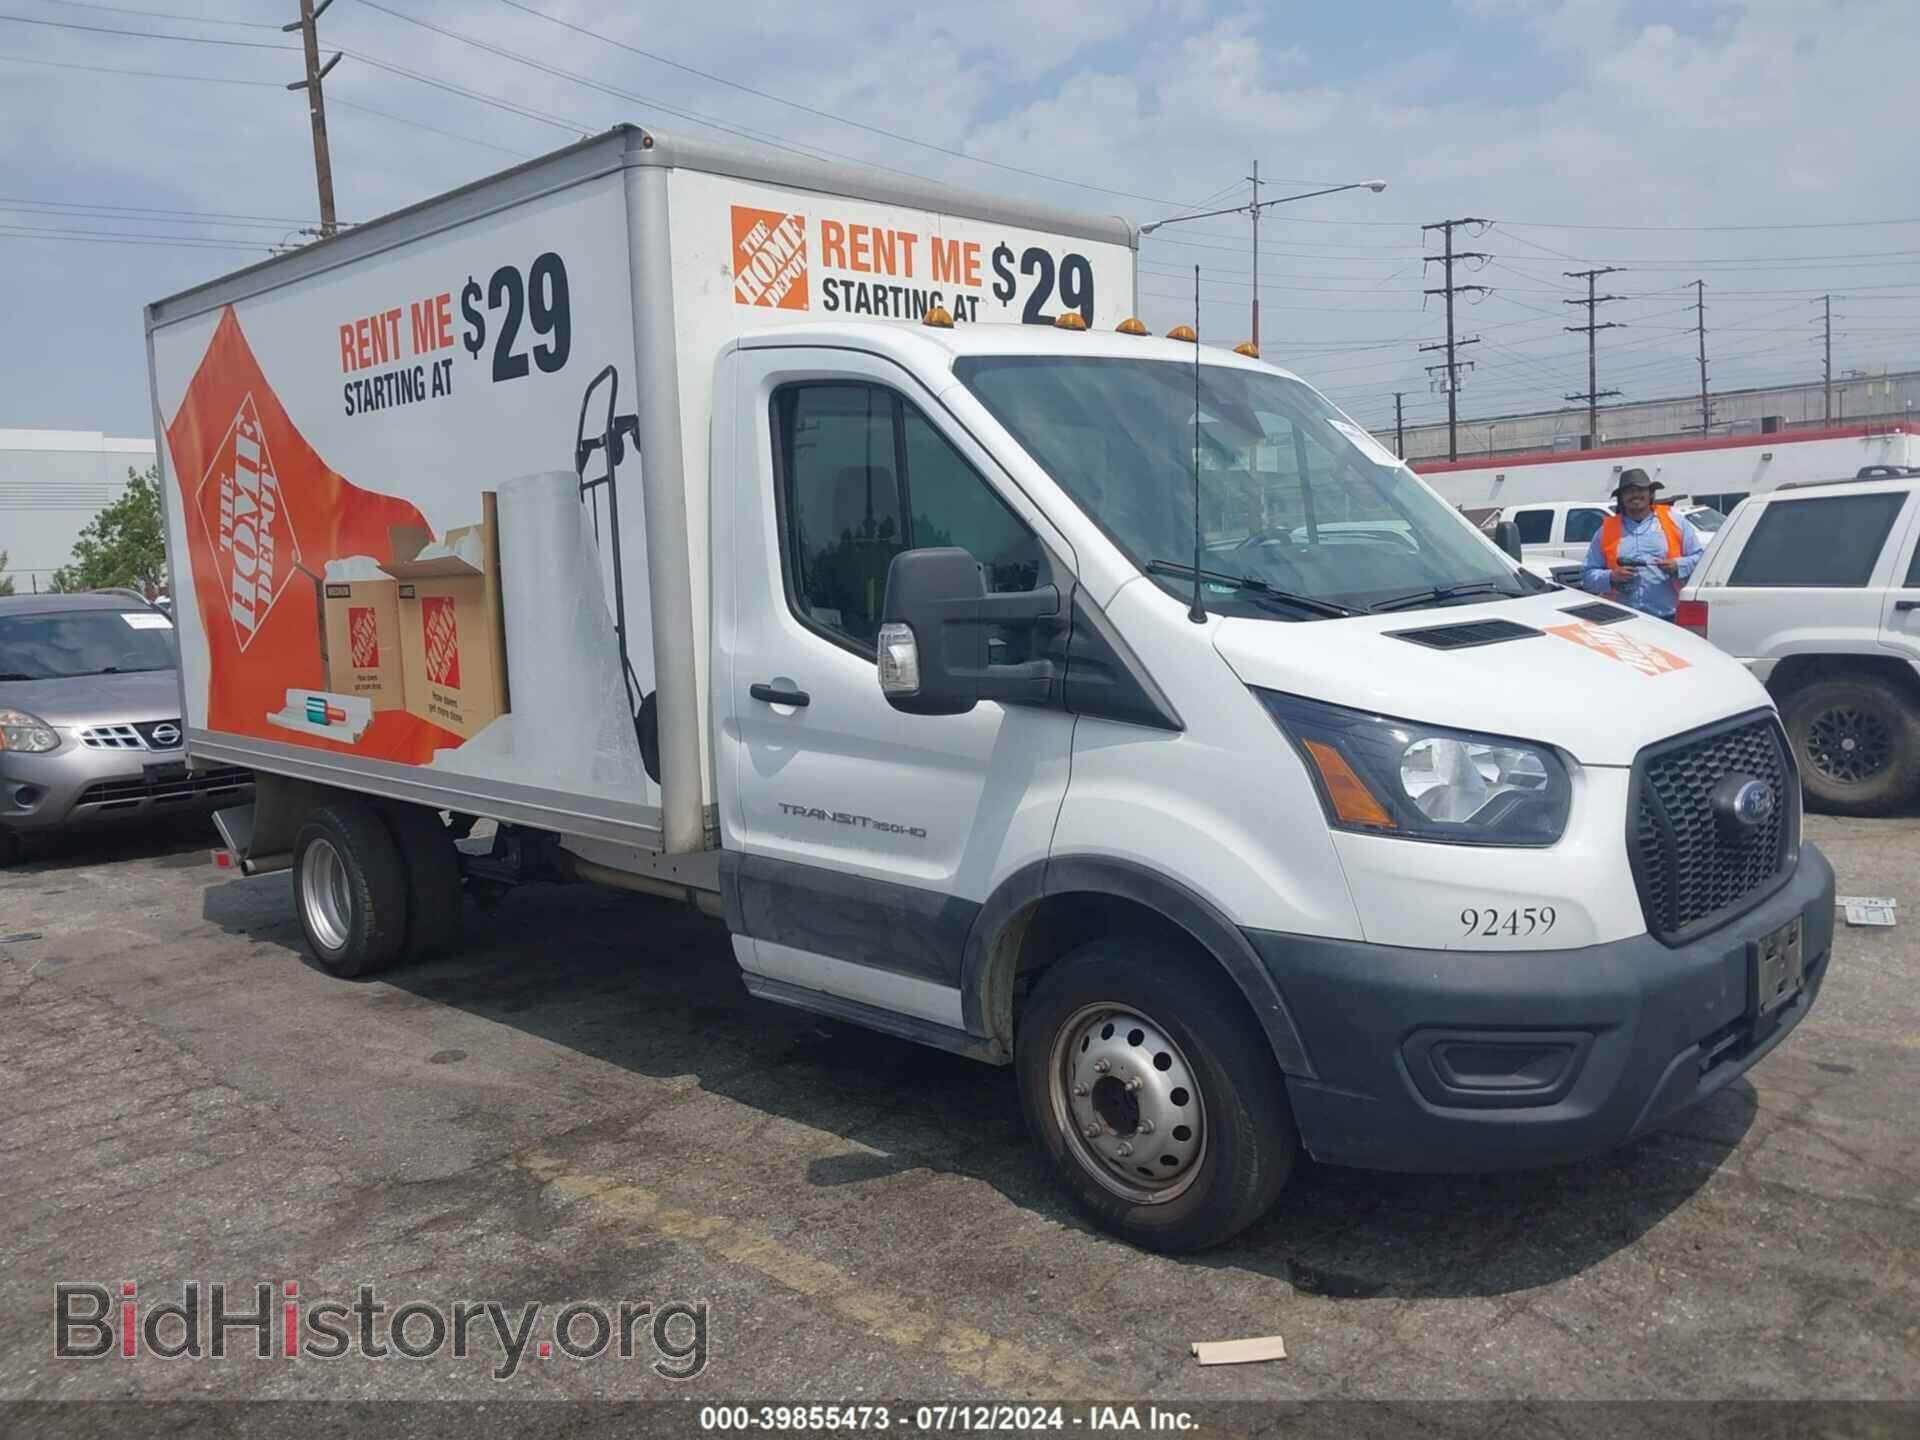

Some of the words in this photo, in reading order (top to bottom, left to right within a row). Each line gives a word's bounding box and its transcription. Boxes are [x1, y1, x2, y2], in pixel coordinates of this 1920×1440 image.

[735, 214, 805, 305] HOME
[739, 219, 770, 257] THE
[820, 219, 918, 279] RENT
[930, 236, 983, 288] ME
[763, 250, 808, 307] DEPOT
[953, 293, 980, 323] AT
[991, 240, 1095, 329] $29
[339, 308, 403, 373] RENT
[410, 292, 455, 355] ME
[460, 252, 572, 383] $29
[343, 365, 426, 416] STARTING
[431, 358, 454, 399] AT
[218, 472, 235, 552] THE
[230, 414, 261, 633] HOME
[256, 463, 279, 607] DEPOT
[777, 802, 873, 828] TRANSIT
[872, 820, 928, 838] 350HD
[1460, 906, 1557, 937] 92459
